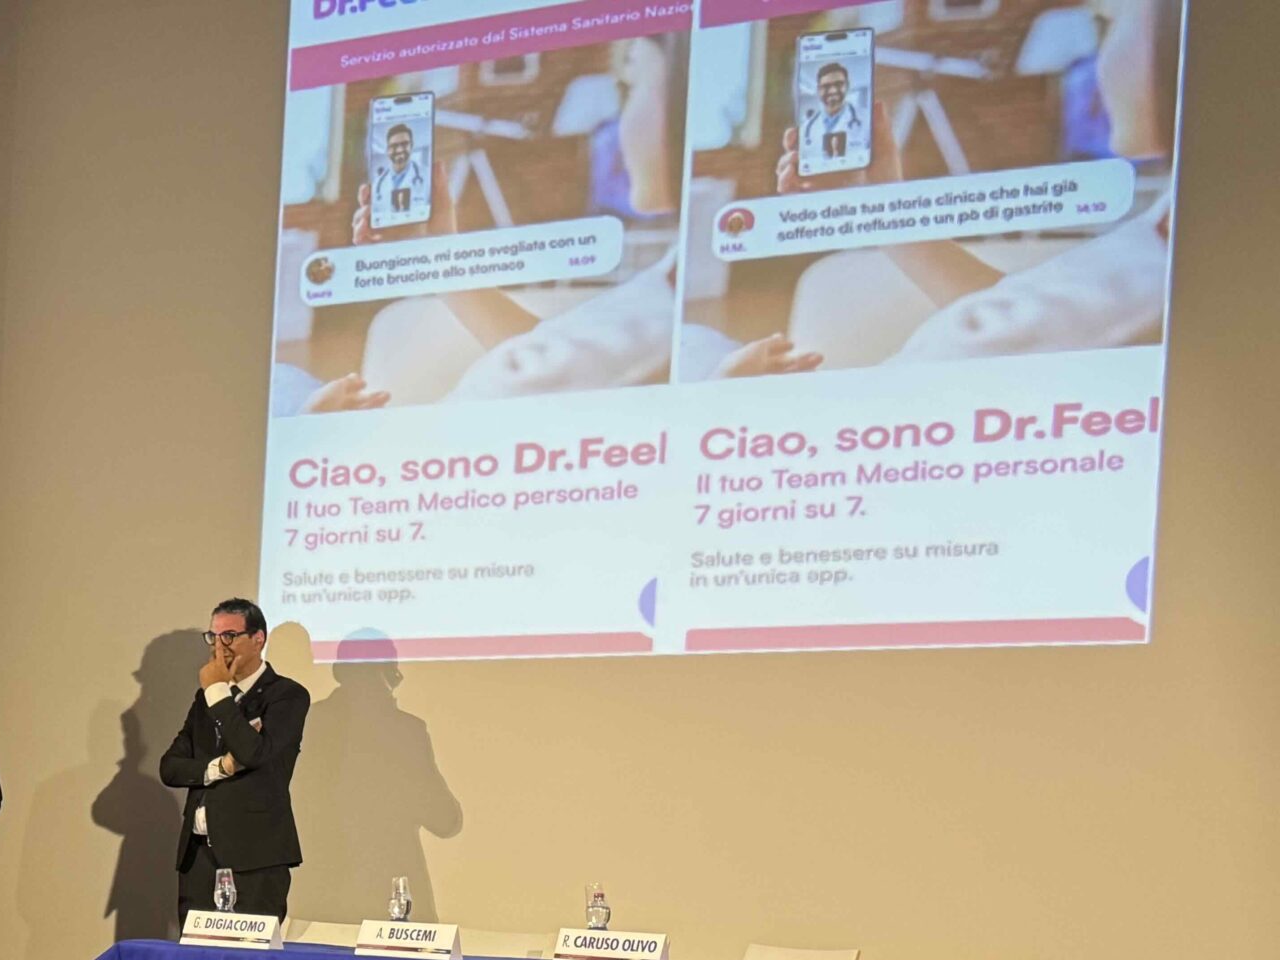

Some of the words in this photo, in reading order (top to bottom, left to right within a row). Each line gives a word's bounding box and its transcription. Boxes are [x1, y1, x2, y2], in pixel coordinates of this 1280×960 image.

[340, 48, 395, 68] Servizio
[399, 36, 478, 58] autorizzato
[482, 31, 505, 45] dal
[509, 22, 567, 41] Sistema
[571, 11, 639, 31] Sanitario
[645, 3, 694, 18] Nazio
[779, 208, 817, 223] Vedo
[820, 203, 857, 219] dalla
[861, 200, 885, 214] tua
[889, 194, 931, 211] storia
[935, 188, 986, 206] clinica
[990, 185, 1020, 200] che
[1024, 181, 1048, 196] hai
[1053, 179, 1078, 197] già
[777, 224, 834, 242] sofferto
[838, 219, 853, 235] di
[857, 215, 916, 233] reflusso
[920, 216, 930, 227] e
[934, 213, 955, 226] un
[982, 204, 999, 220] di
[1002, 199, 1064, 221] gastrite
[355, 252, 431, 273] Buongiorno,
[434, 249, 450, 263] mi
[454, 247, 485, 261] sono
[489, 239, 545, 259] svegliata
[549, 236, 575, 250] con
[578, 233, 596, 246] un
[354, 275, 384, 289] forte
[387, 269, 439, 285] bruciore
[442, 265, 466, 279] allo
[469, 260, 525, 276] stomaco
[699, 425, 818, 461] Ciao,
[835, 422, 955, 452] sono
[973, 396, 1160, 443] Dr.Feel
[288, 457, 387, 489] Ciao,
[400, 454, 499, 482] sono
[514, 430, 668, 474] Dr.Feel
[696, 473, 710, 495] Il
[720, 474, 763, 493] tuo
[771, 467, 846, 490] Team
[856, 460, 964, 486] Medico
[973, 449, 1124, 483] personale
[286, 500, 298, 519] Il
[305, 500, 341, 518] tuo
[348, 496, 410, 516] Team
[418, 488, 507, 512] Medico
[513, 479, 639, 511] personale
[694, 504, 711, 525] 7
[717, 500, 796, 530] giorni
[804, 502, 836, 520] su
[845, 495, 867, 518] 7.
[284, 528, 299, 547] 7
[304, 524, 368, 551] giorni
[375, 527, 401, 543] su
[408, 521, 426, 541] 7.
[691, 550, 754, 569] Salute
[759, 552, 773, 566] e
[778, 546, 888, 565] benessere
[893, 546, 918, 560] su
[924, 540, 999, 559] misura
[282, 570, 335, 587] Salute
[338, 572, 350, 584] e
[353, 566, 444, 584] benessere
[448, 566, 468, 580] su
[473, 562, 535, 579] misura
[689, 572, 708, 588] in
[712, 569, 801, 587] un'unica
[807, 568, 854, 586] app.
[281, 589, 298, 604] in
[300, 587, 372, 604] un'unica
[377, 587, 416, 604] app.
[193, 916, 202, 928] G.
[205, 917, 266, 933] DIGIACOMO
[388, 927, 437, 942] BUSCEMI
[573, 935, 619, 951] CARUSO
[622, 939, 658, 953] OLIVO
